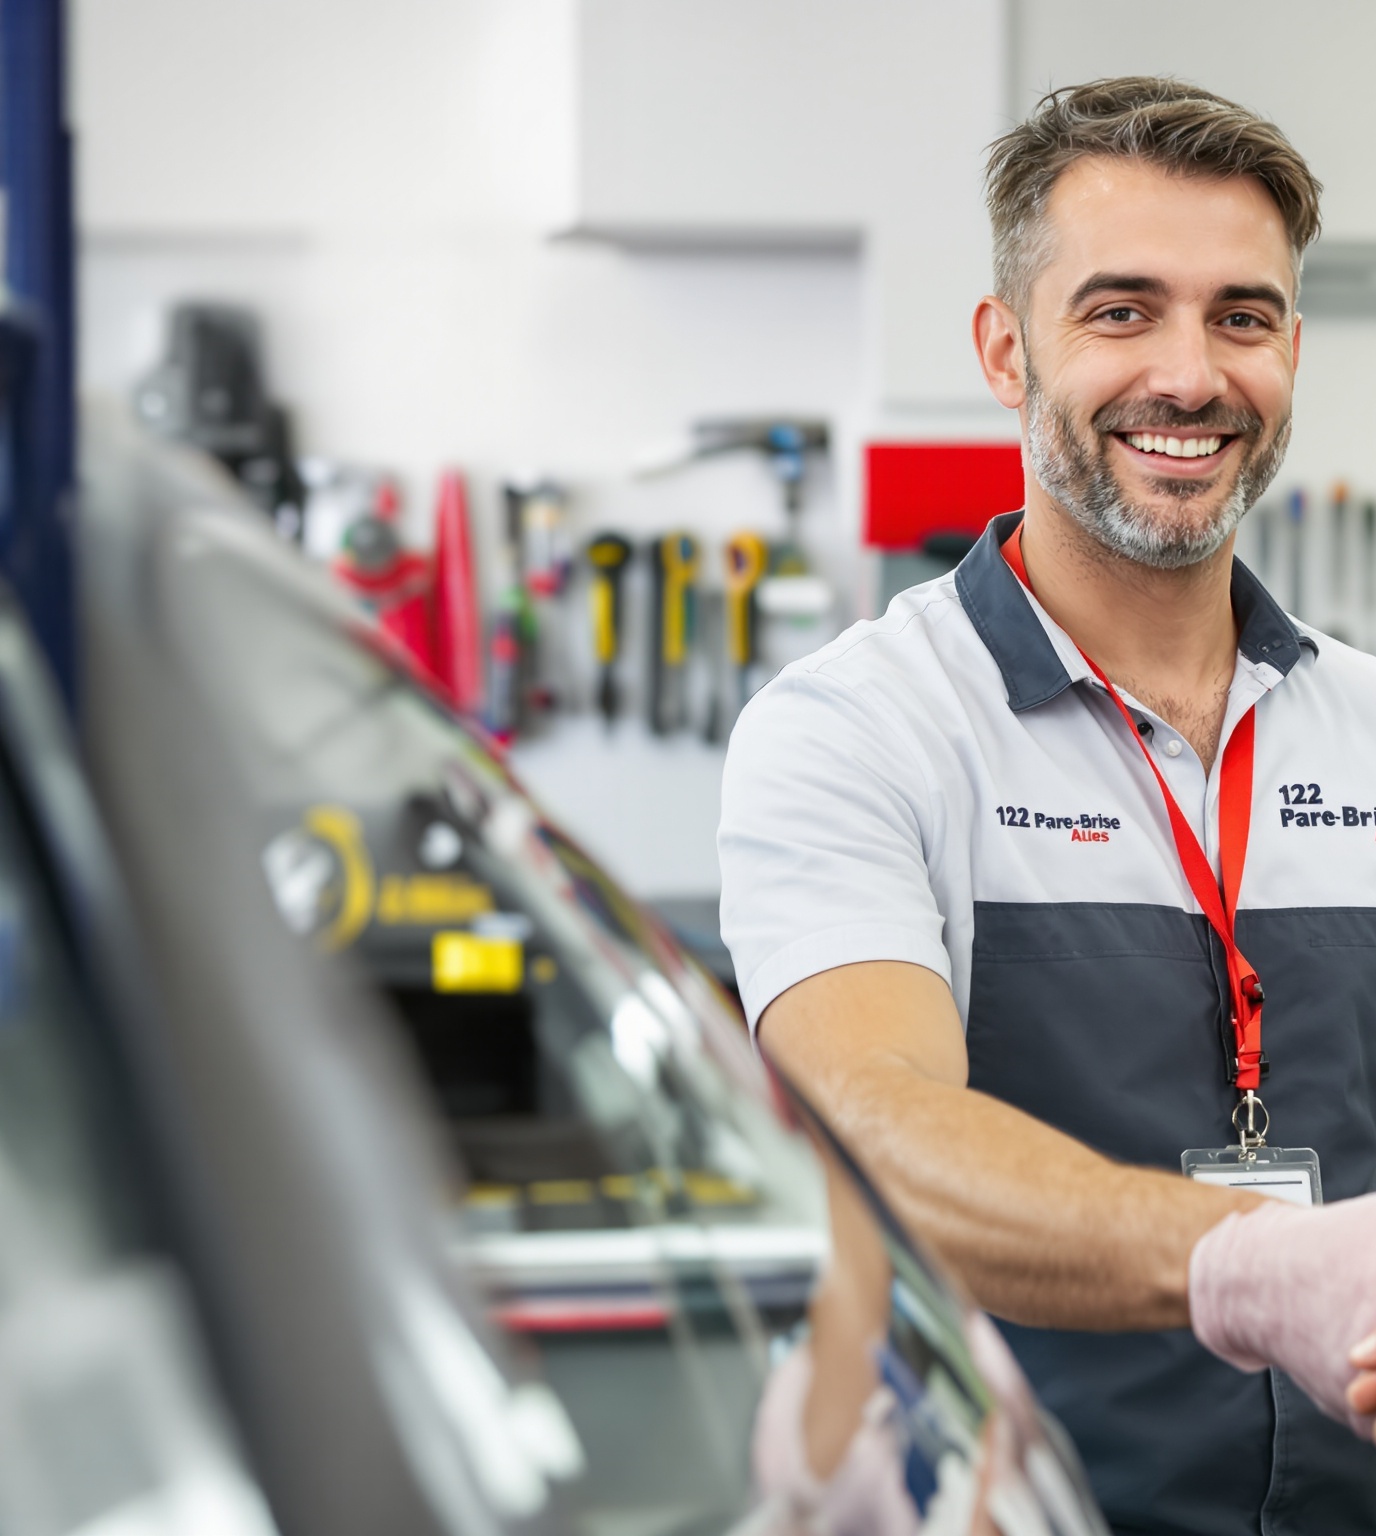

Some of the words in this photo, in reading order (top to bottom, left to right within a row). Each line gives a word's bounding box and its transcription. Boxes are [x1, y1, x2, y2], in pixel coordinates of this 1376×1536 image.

[1278, 783, 1323, 805] 122
[996, 806, 1031, 828] 122
[1034, 813, 1121, 829] Pare-Brise
